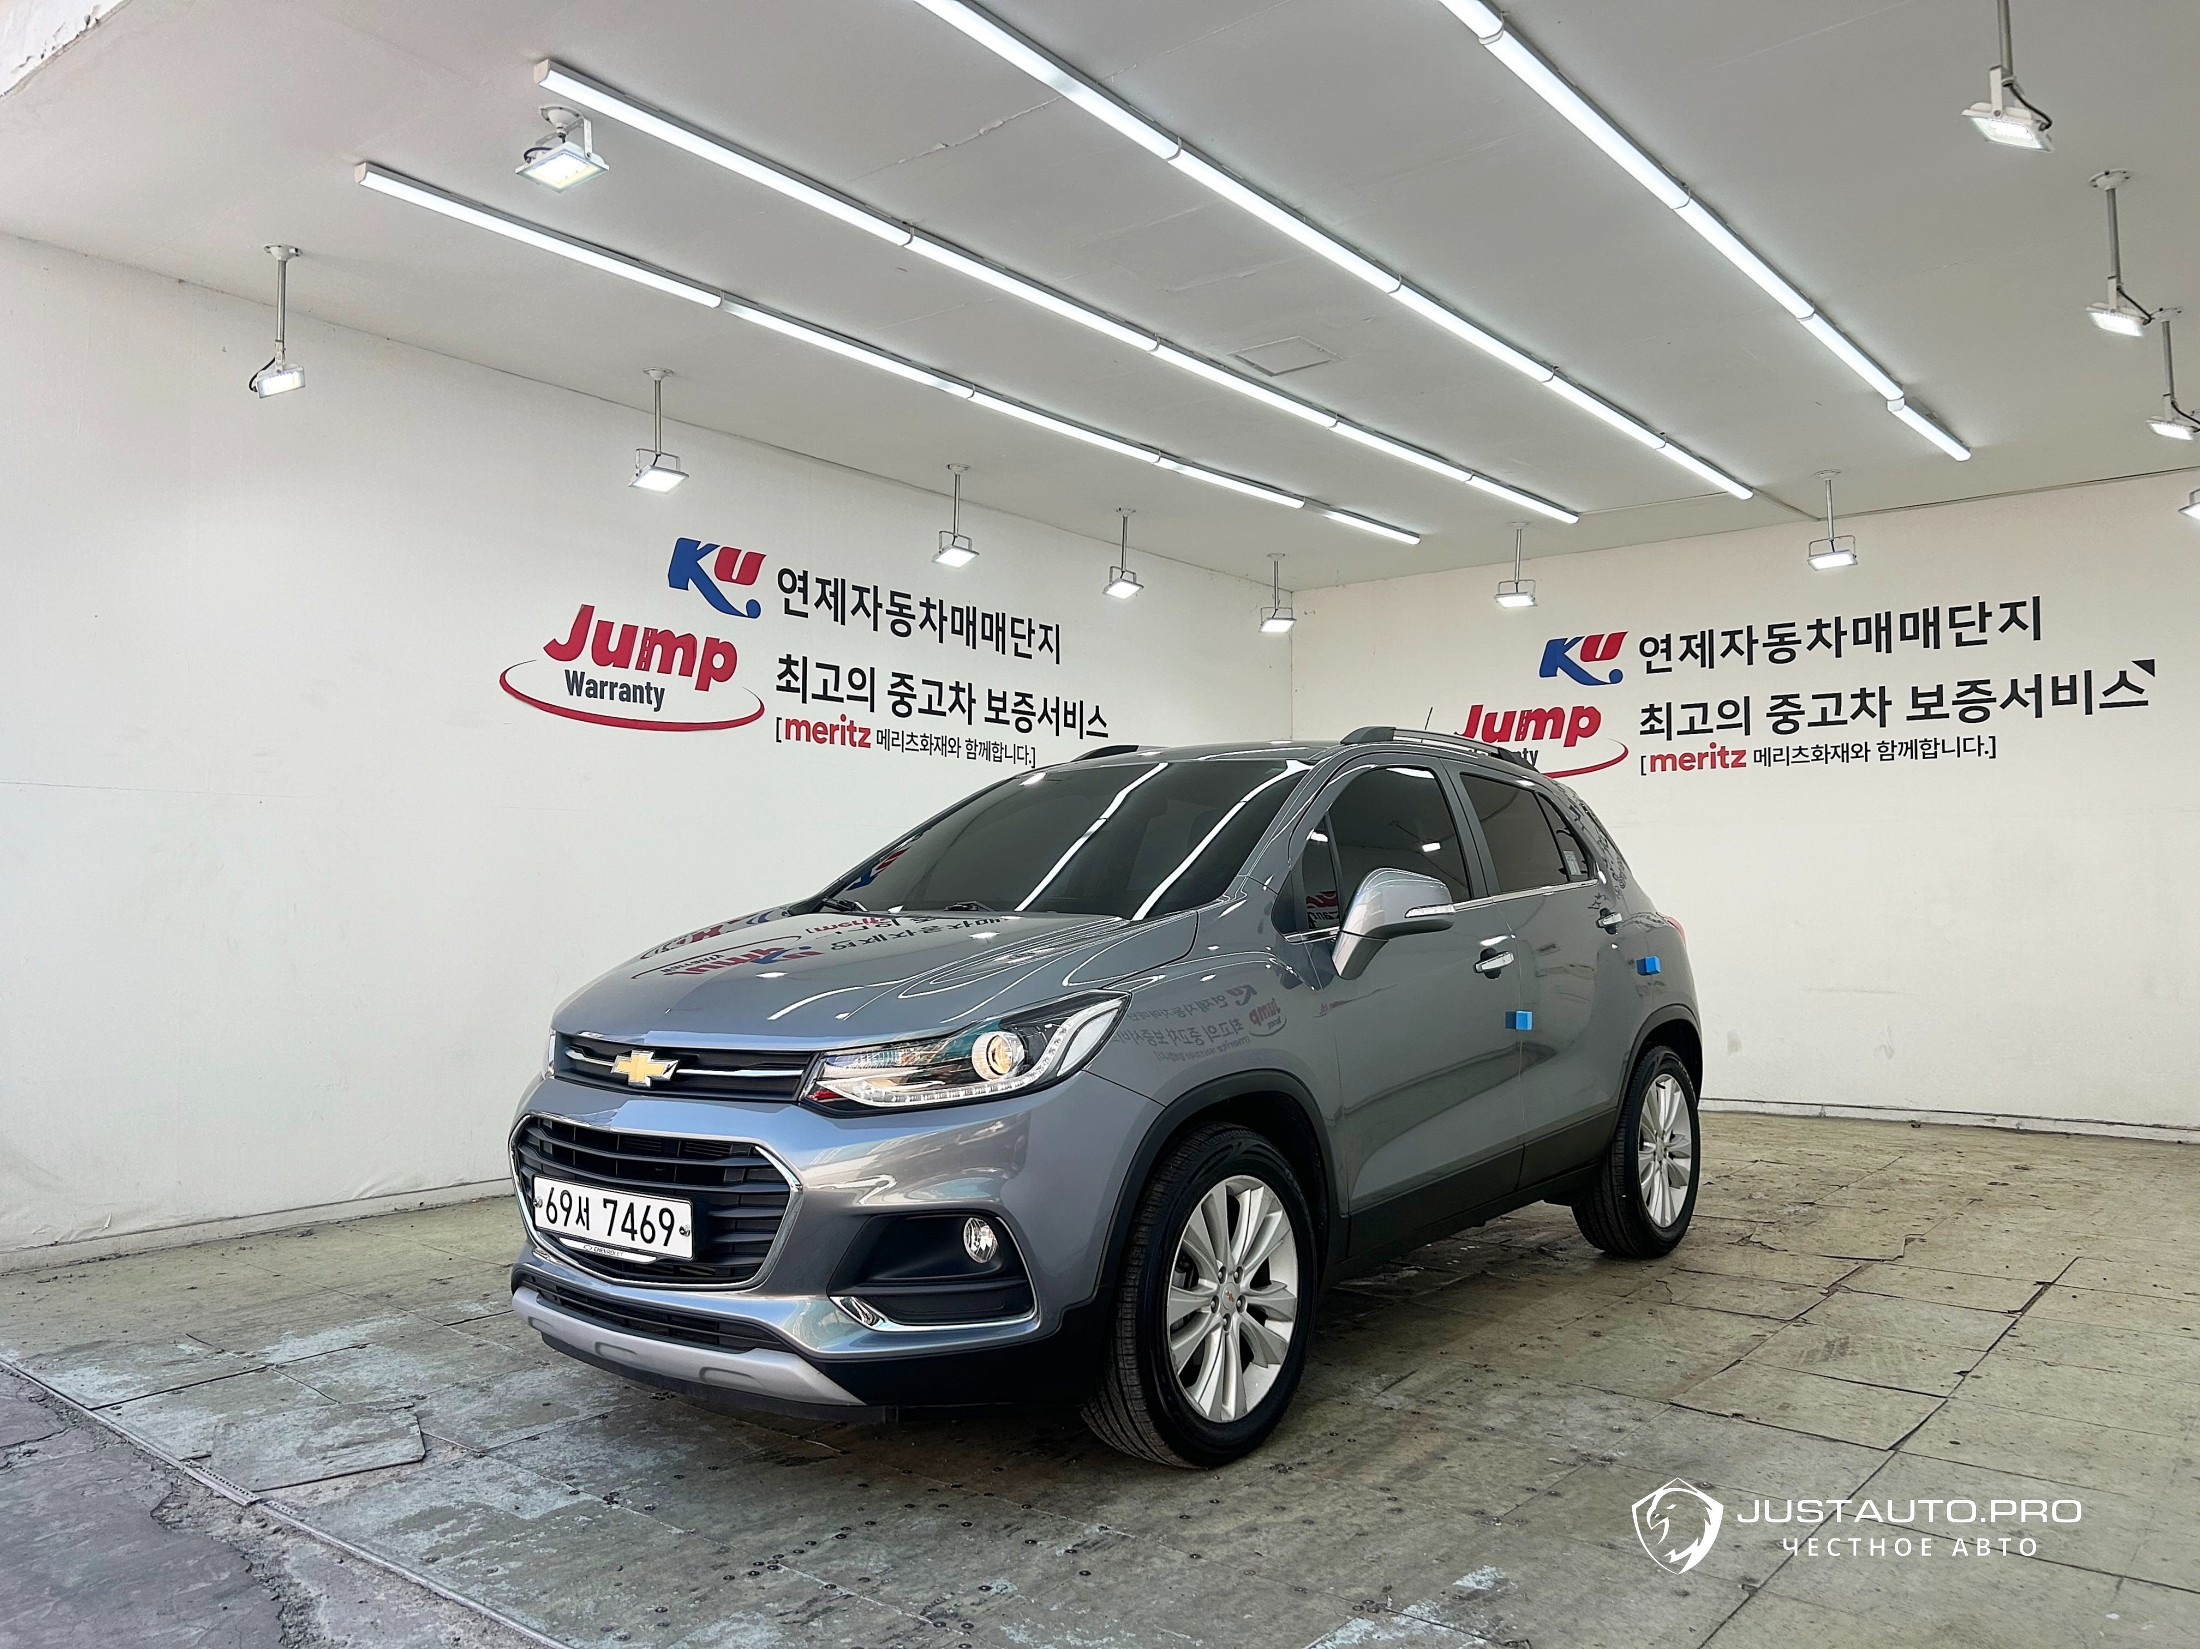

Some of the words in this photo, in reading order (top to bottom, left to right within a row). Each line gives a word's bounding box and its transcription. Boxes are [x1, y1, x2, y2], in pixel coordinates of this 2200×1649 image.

[543, 604, 738, 692] Jump
[777, 567, 1061, 665] 연제자동차매매단지
[1639, 595, 2041, 674] 연제자동차매매단지
[565, 669, 665, 712] Warranty
[775, 653, 876, 713] 최고의
[887, 671, 977, 726] 중고차
[984, 688, 1109, 740] 보증서비스
[1639, 695, 1751, 741] 최고의
[1766, 685, 1893, 735] 중고차
[1906, 669, 2149, 723] 보증서비스
[876, 729, 962, 759] 메리츠화재와
[1454, 704, 1602, 747] Jump
[1753, 741, 1871, 767] 메리츠화재와
[545, 1187, 590, 1230] 69서
[602, 1198, 675, 1247] 7469
